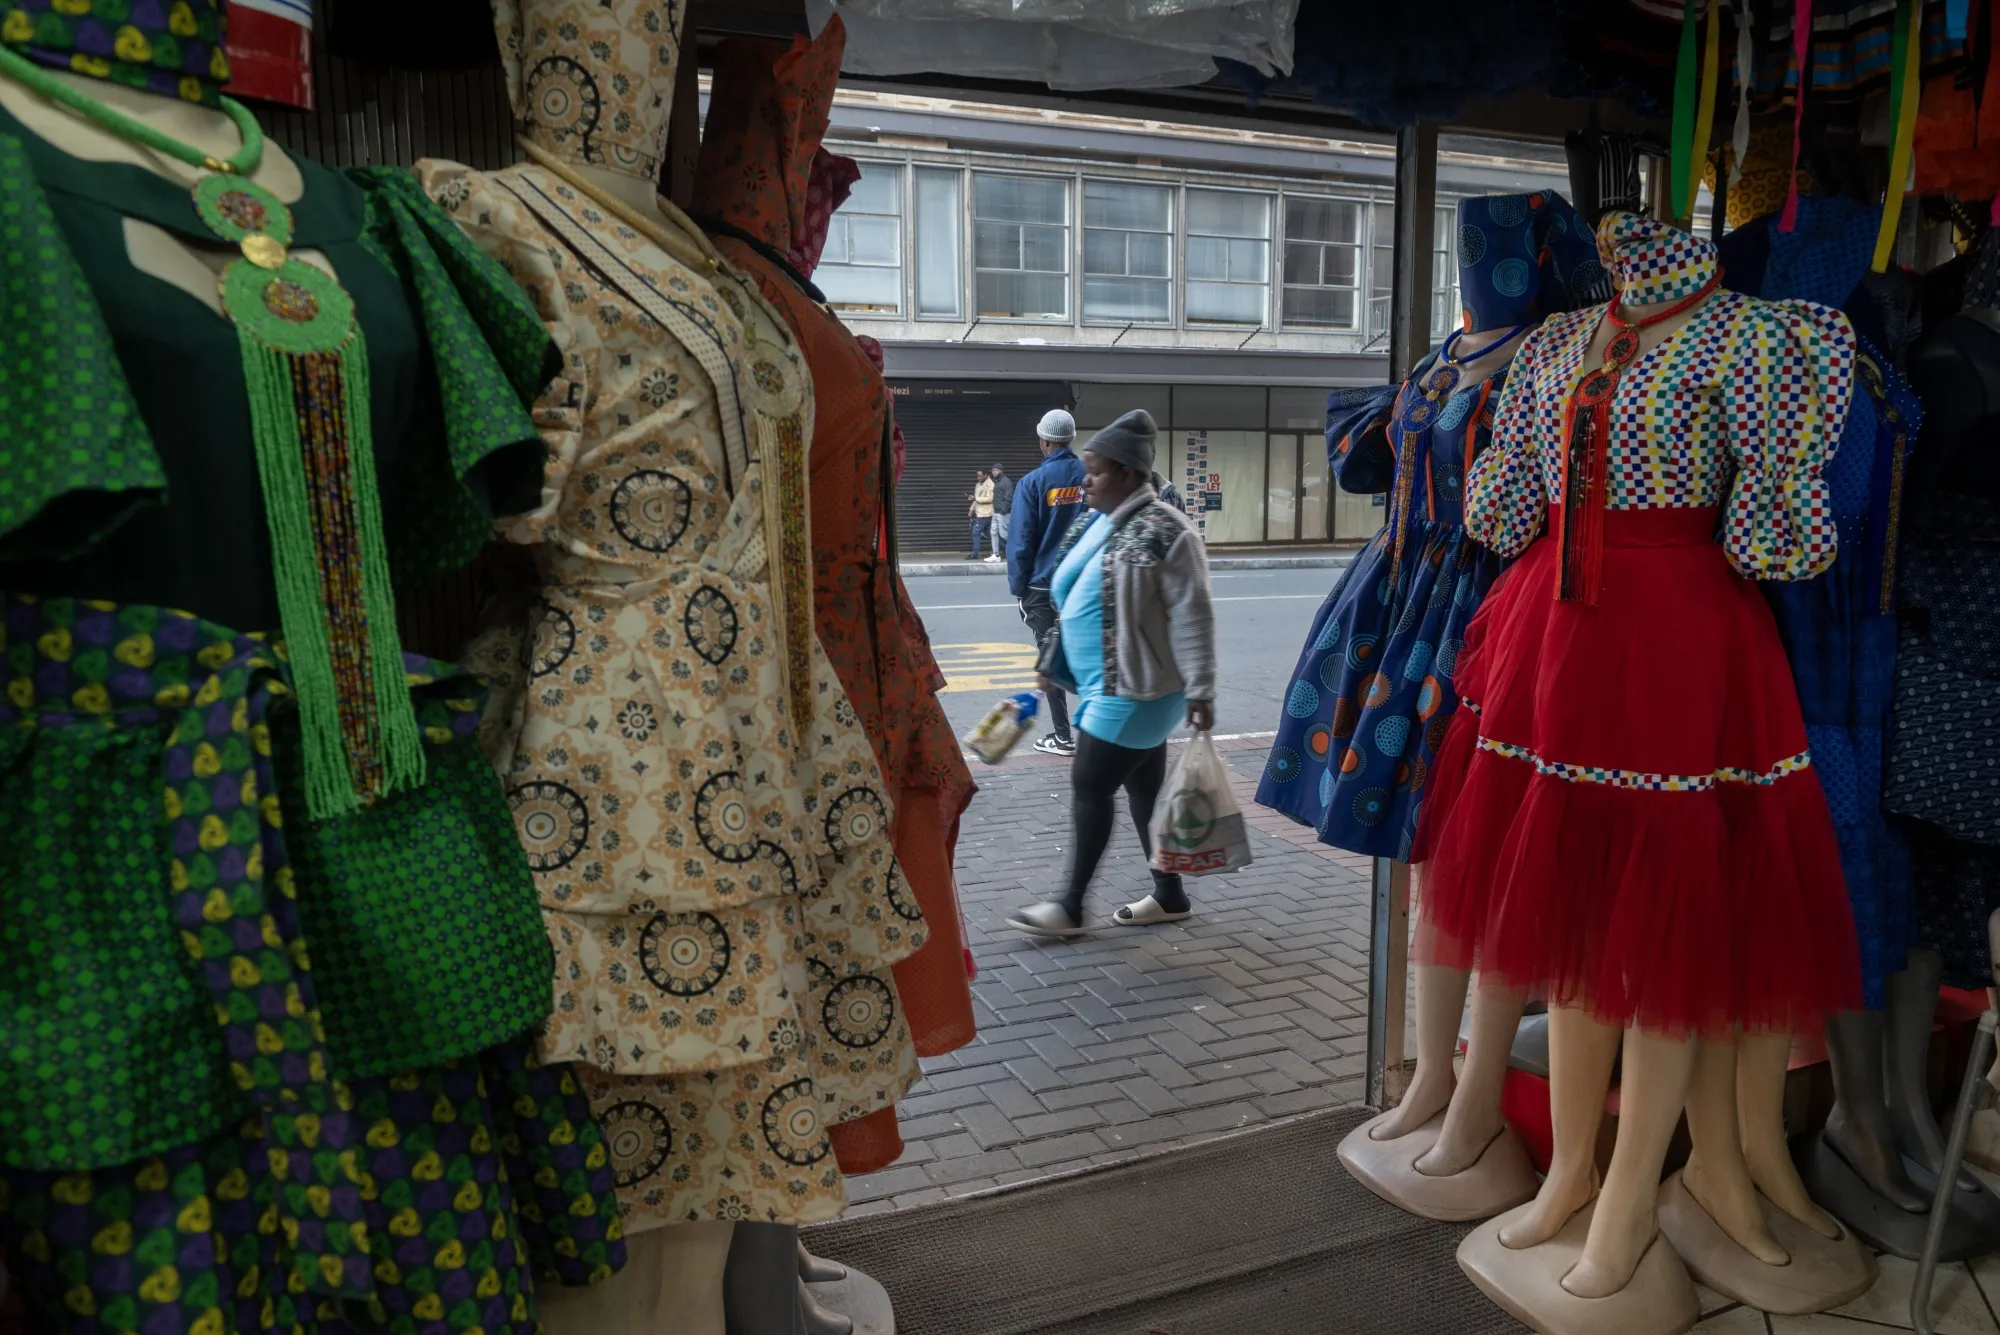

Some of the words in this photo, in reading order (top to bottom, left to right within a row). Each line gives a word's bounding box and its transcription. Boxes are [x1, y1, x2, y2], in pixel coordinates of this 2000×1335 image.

[1208, 474, 1220, 482] TO
[1207, 483, 1220, 491] LET
[1160, 852, 1225, 870] SPAR
